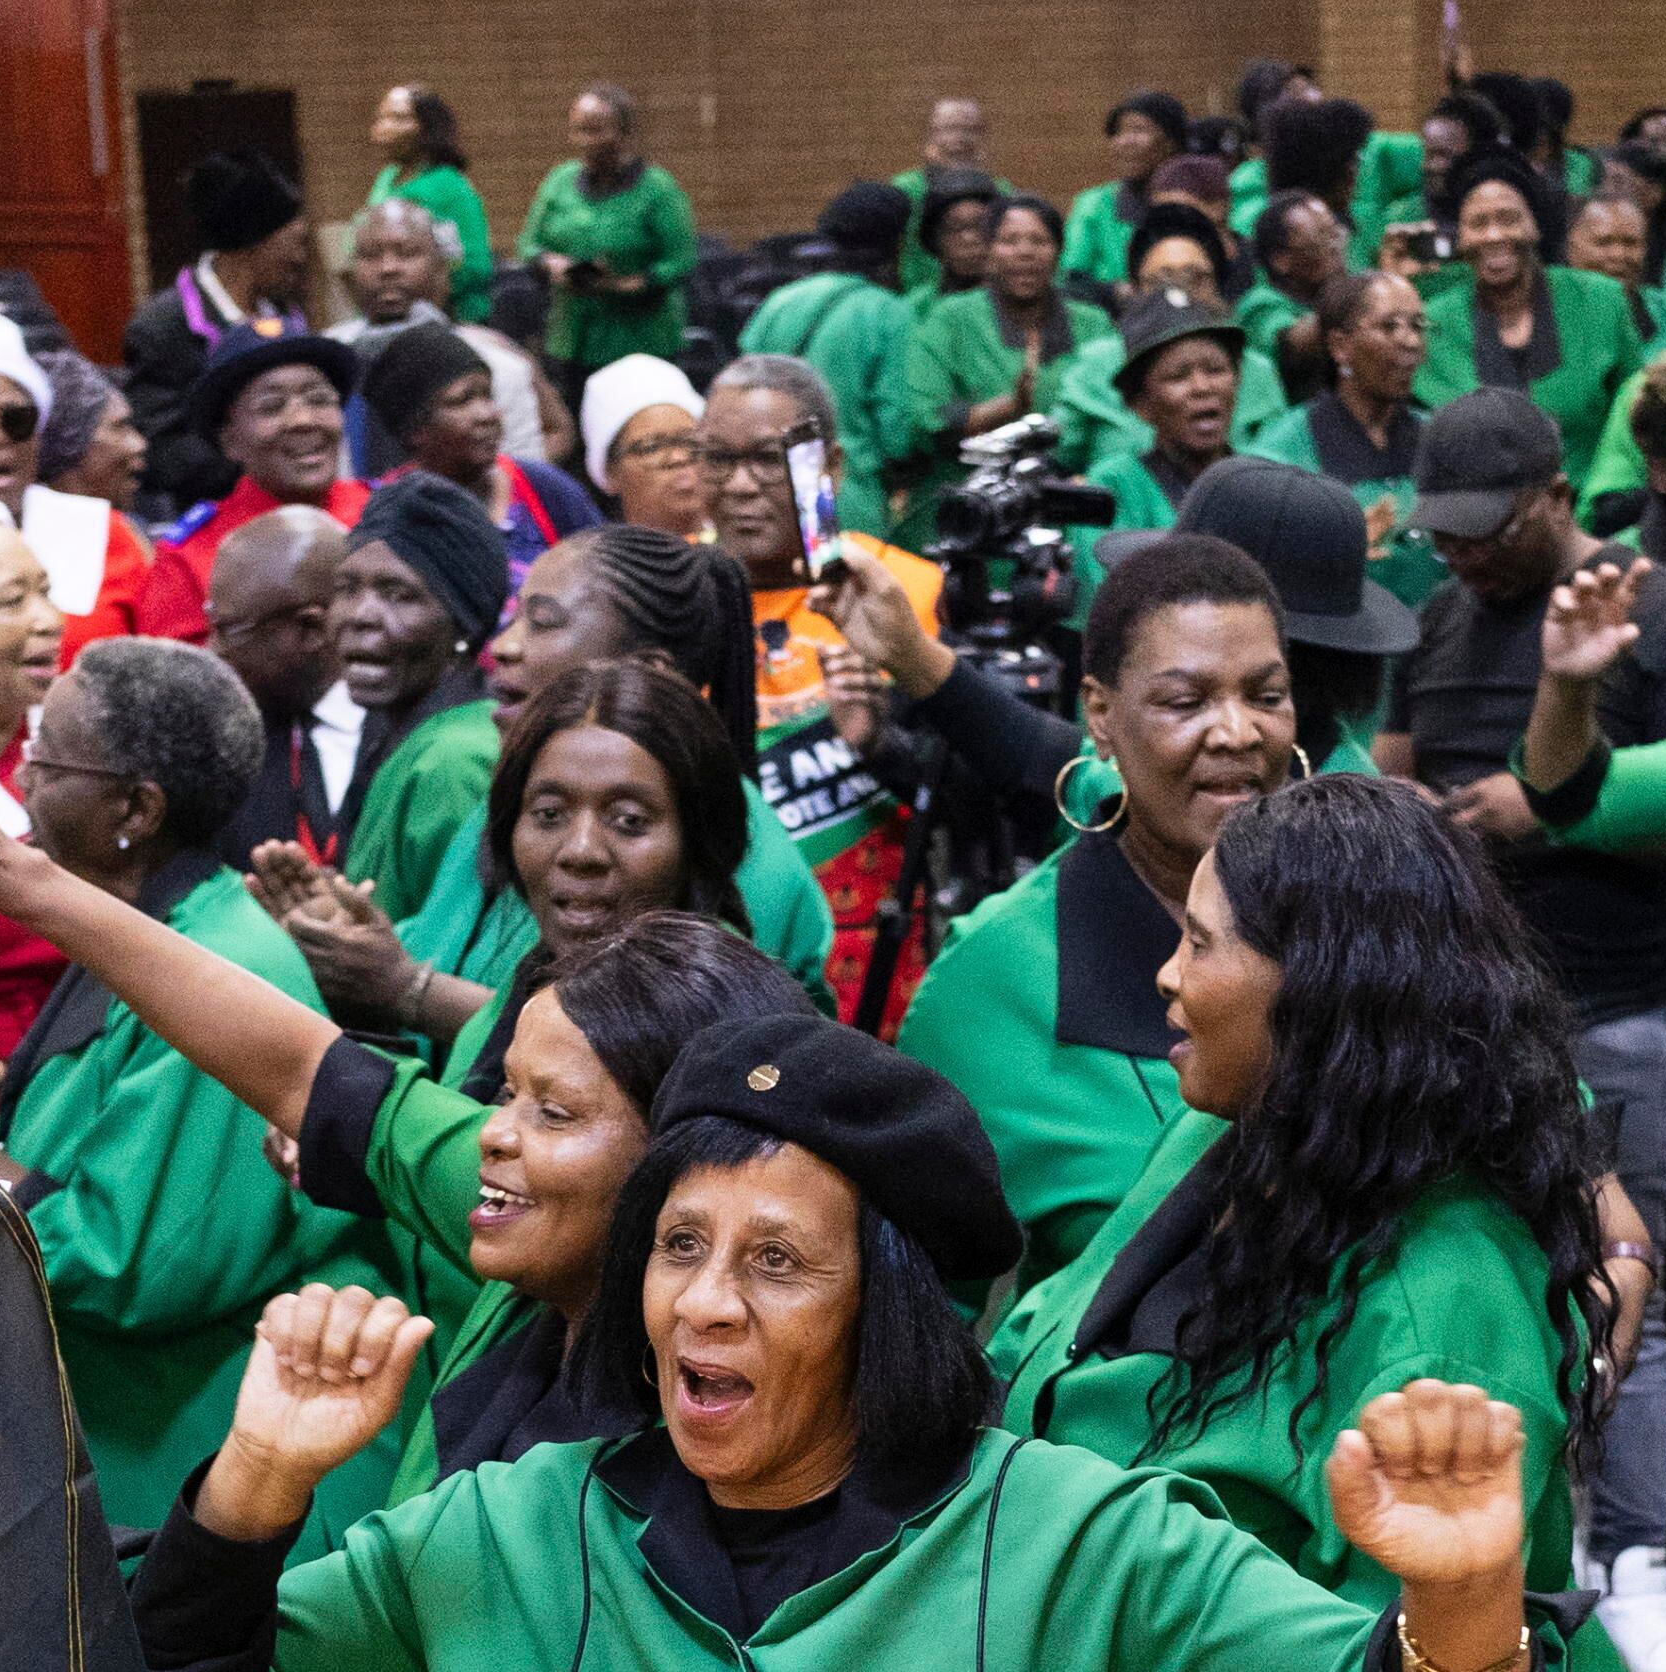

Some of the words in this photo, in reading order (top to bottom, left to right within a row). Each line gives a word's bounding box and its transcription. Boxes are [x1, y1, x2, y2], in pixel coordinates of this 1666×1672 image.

[758, 761, 788, 802] E
[790, 737, 856, 789] AN
[776, 786, 835, 829] OTE
